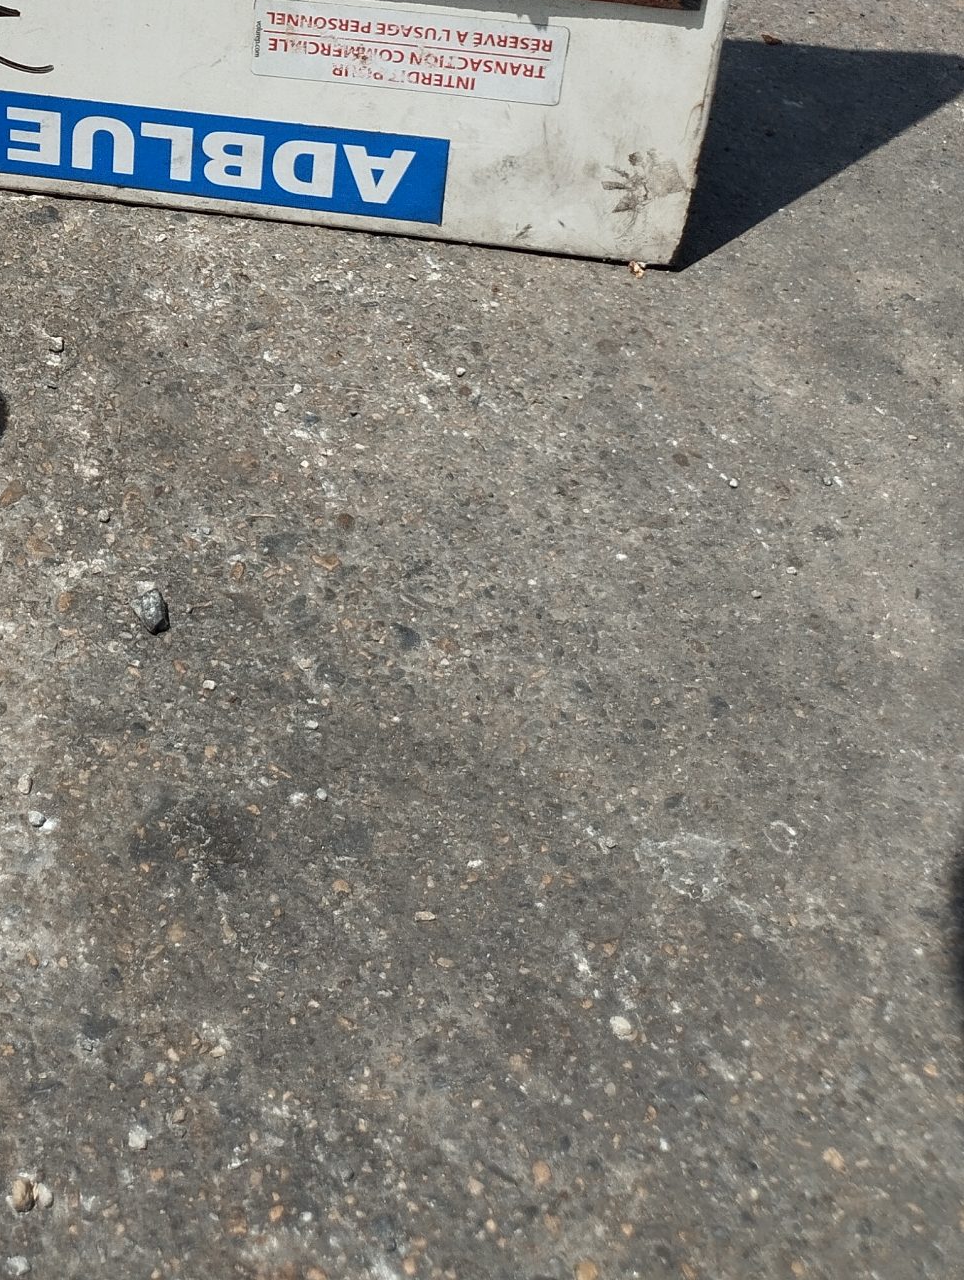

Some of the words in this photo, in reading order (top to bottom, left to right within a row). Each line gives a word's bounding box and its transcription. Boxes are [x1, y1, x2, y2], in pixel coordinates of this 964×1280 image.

[266, 11, 372, 34] PERSONNEL
[456, 30, 469, 47] À
[473, 32, 553, 54] RÉSERVÉ
[409, 51, 546, 79] TRANSACTION
[6, 106, 416, 204] ADBLUE
